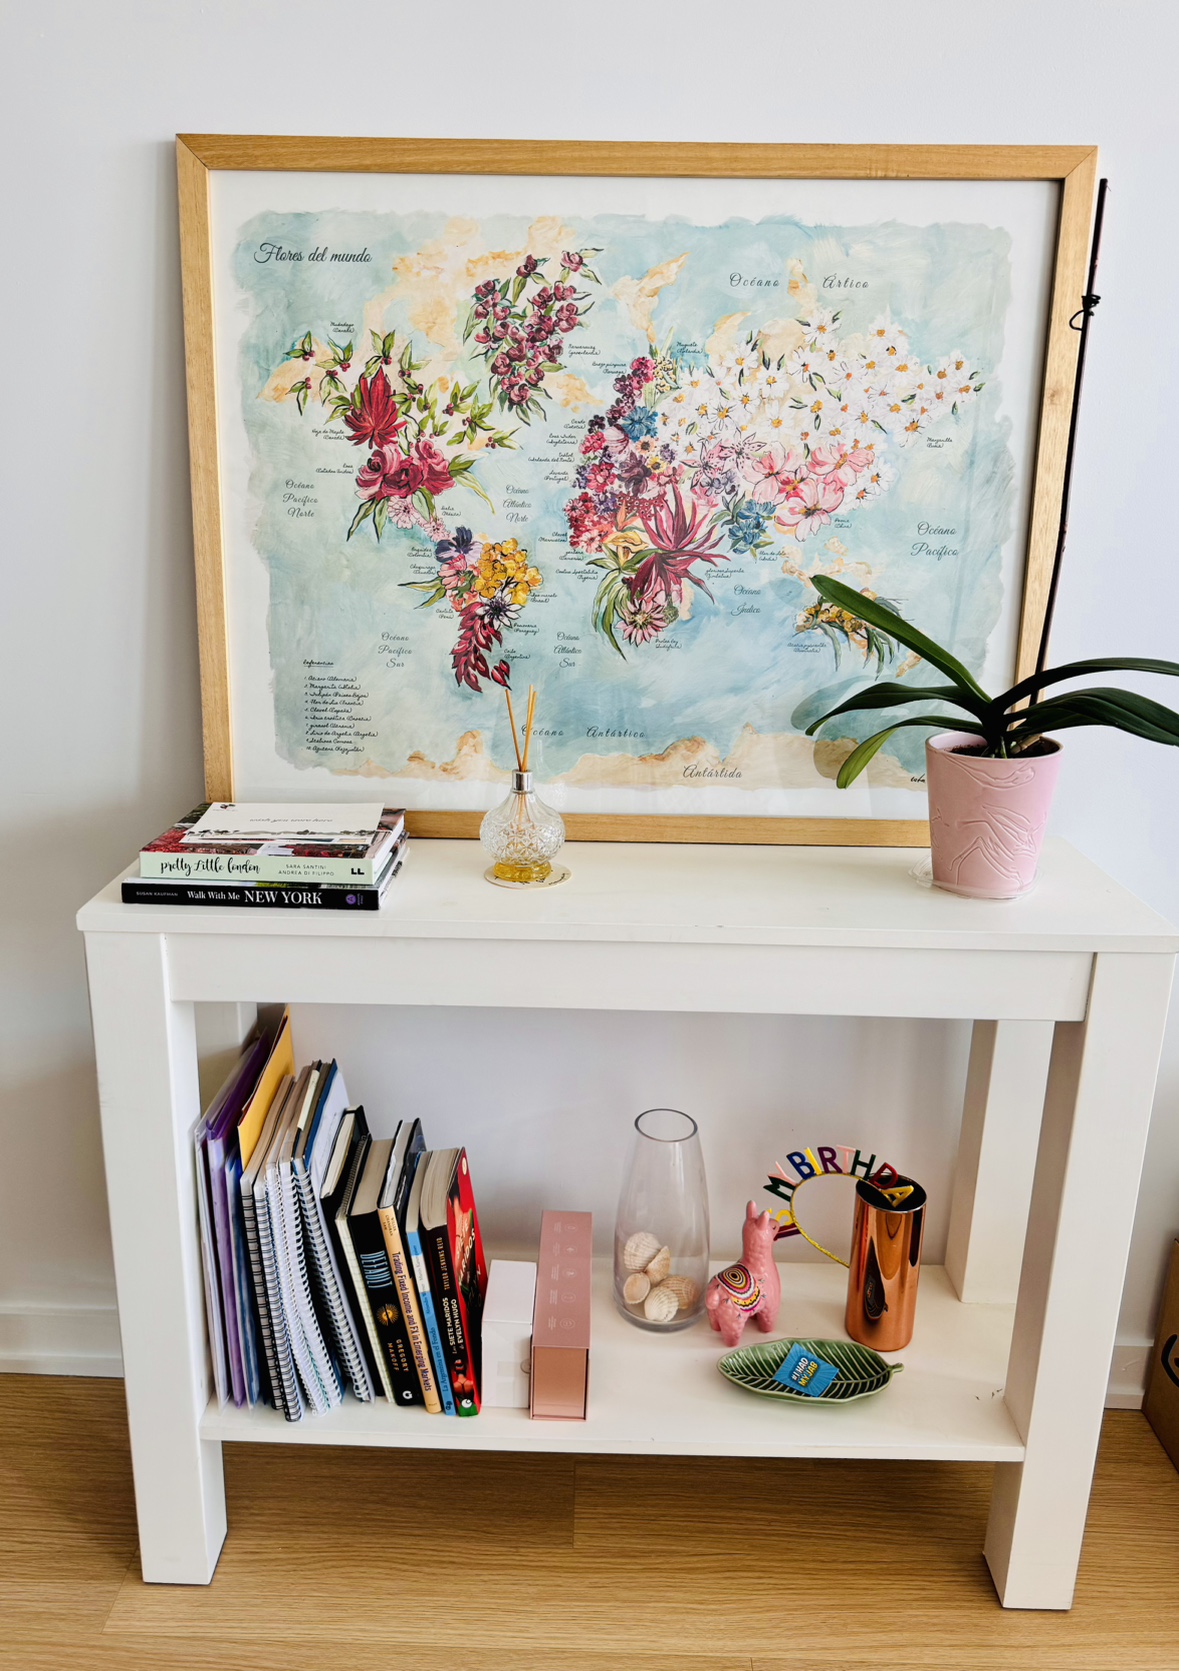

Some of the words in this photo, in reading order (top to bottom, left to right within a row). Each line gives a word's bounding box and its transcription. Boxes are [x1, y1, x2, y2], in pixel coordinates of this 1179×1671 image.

[254, 242, 304, 264] Flores
[308, 247, 327, 262] del
[330, 247, 373, 263] mundo
[729, 272, 780, 288] Océano
[822, 273, 869, 289] Ártico
[285, 479, 315, 489] Océano
[505, 484, 530, 494] Océano
[282, 493, 318, 506] Pacífico
[502, 498, 531, 508] Atlántico
[287, 507, 315, 518] Norte
[506, 512, 528, 523] Norte
[917, 522, 957, 536] Océano
[910, 542, 958, 562] Pacífico
[734, 585, 761, 596] Océano
[381, 632, 409, 642] Océano
[556, 631, 580, 641] Océano
[378, 645, 412, 656] Pacífico
[386, 658, 405, 668] Sur
[559, 657, 575, 668] Sur
[586, 725, 645, 738] Antártico
[682, 764, 743, 780] Antártida
[160, 859, 192, 876] pretty
[227, 858, 261, 873] london
[187, 890, 206, 901] Walk
[207, 890, 226, 901] With
[227, 891, 240, 901] Me
[244, 890, 278, 904] NEW
[280, 891, 323, 905] YORK
[786, 1144, 914, 1208] BIRTHDA
[436, 1236, 444, 1249] REID
[392, 1251, 403, 1275] Trading
[438, 1249, 447, 1271] JENKINS
[360, 1249, 393, 1289] DEFAULT
[397, 1274, 407, 1290] Fixed
[441, 1272, 450, 1289] TAYLOR
[401, 1290, 412, 1313] Income
[450, 1298, 459, 1318] HUGO
[407, 1313, 417, 1326] and
[442, 1297, 452, 1326] MARIDOS
[409, 1325, 419, 1334] FX
[431, 1326, 440, 1347] Fondo
[447, 1327, 455, 1345] SIETE
[454, 1319, 463, 1343] EVELYN
[388, 1342, 399, 1371] MAKOFF
[396, 1339, 409, 1372] GREGORY
[412, 1340, 426, 1369] Emerging
[437, 1358, 448, 1384] Argentina
[795, 1357, 809, 1374] HAD
[798, 1374, 810, 1387] MY
[806, 1360, 819, 1378] JAB
[420, 1368, 432, 1391] Markets
[442, 1384, 448, 1392] La
